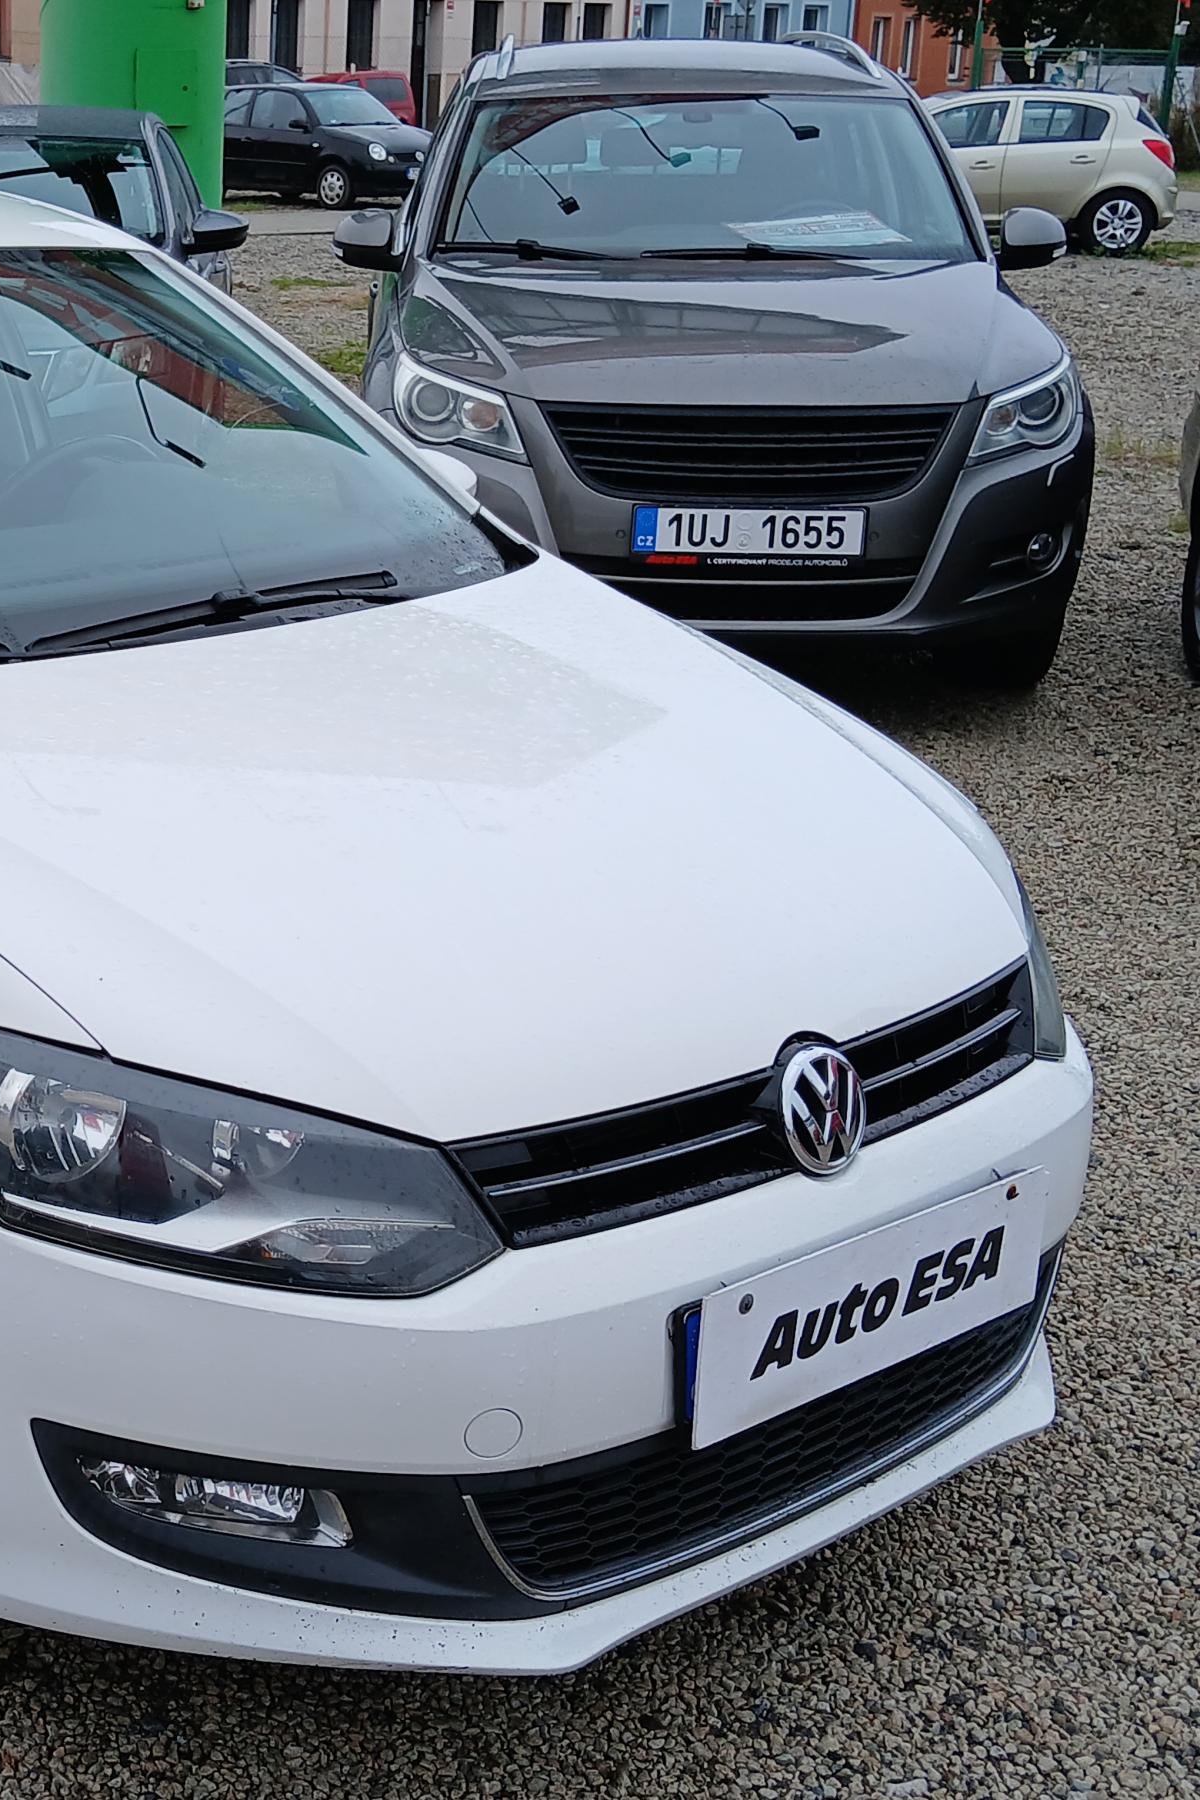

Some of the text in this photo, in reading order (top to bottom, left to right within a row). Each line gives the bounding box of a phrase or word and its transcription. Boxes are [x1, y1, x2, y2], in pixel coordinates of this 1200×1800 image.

[637, 535, 654, 547] CZ
[667, 513, 847, 550] 1UJ 1655
[749, 1225, 1006, 1381] Auto ESA
